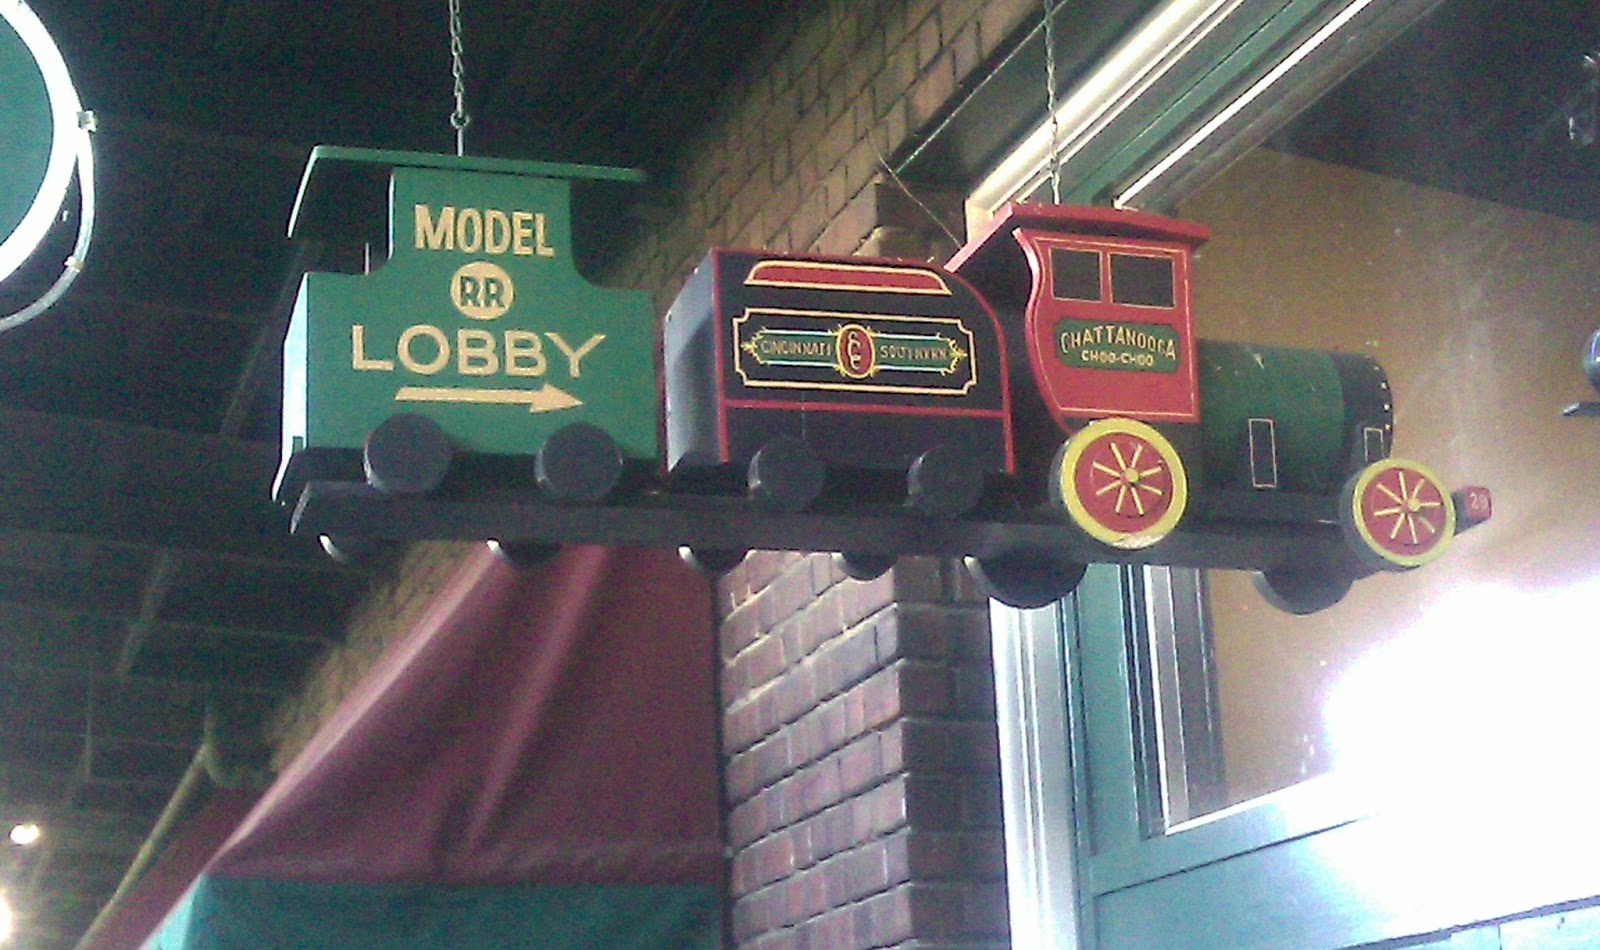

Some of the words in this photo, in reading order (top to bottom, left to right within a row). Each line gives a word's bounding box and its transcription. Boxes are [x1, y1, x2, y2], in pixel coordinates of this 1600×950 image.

[414, 203, 556, 258] MODEL
[459, 275, 505, 308] RR
[352, 324, 607, 379] LOBBY
[1060, 324, 1177, 361] CHATTANOOGA
[1081, 350, 1155, 366] CHOO-CHOO
